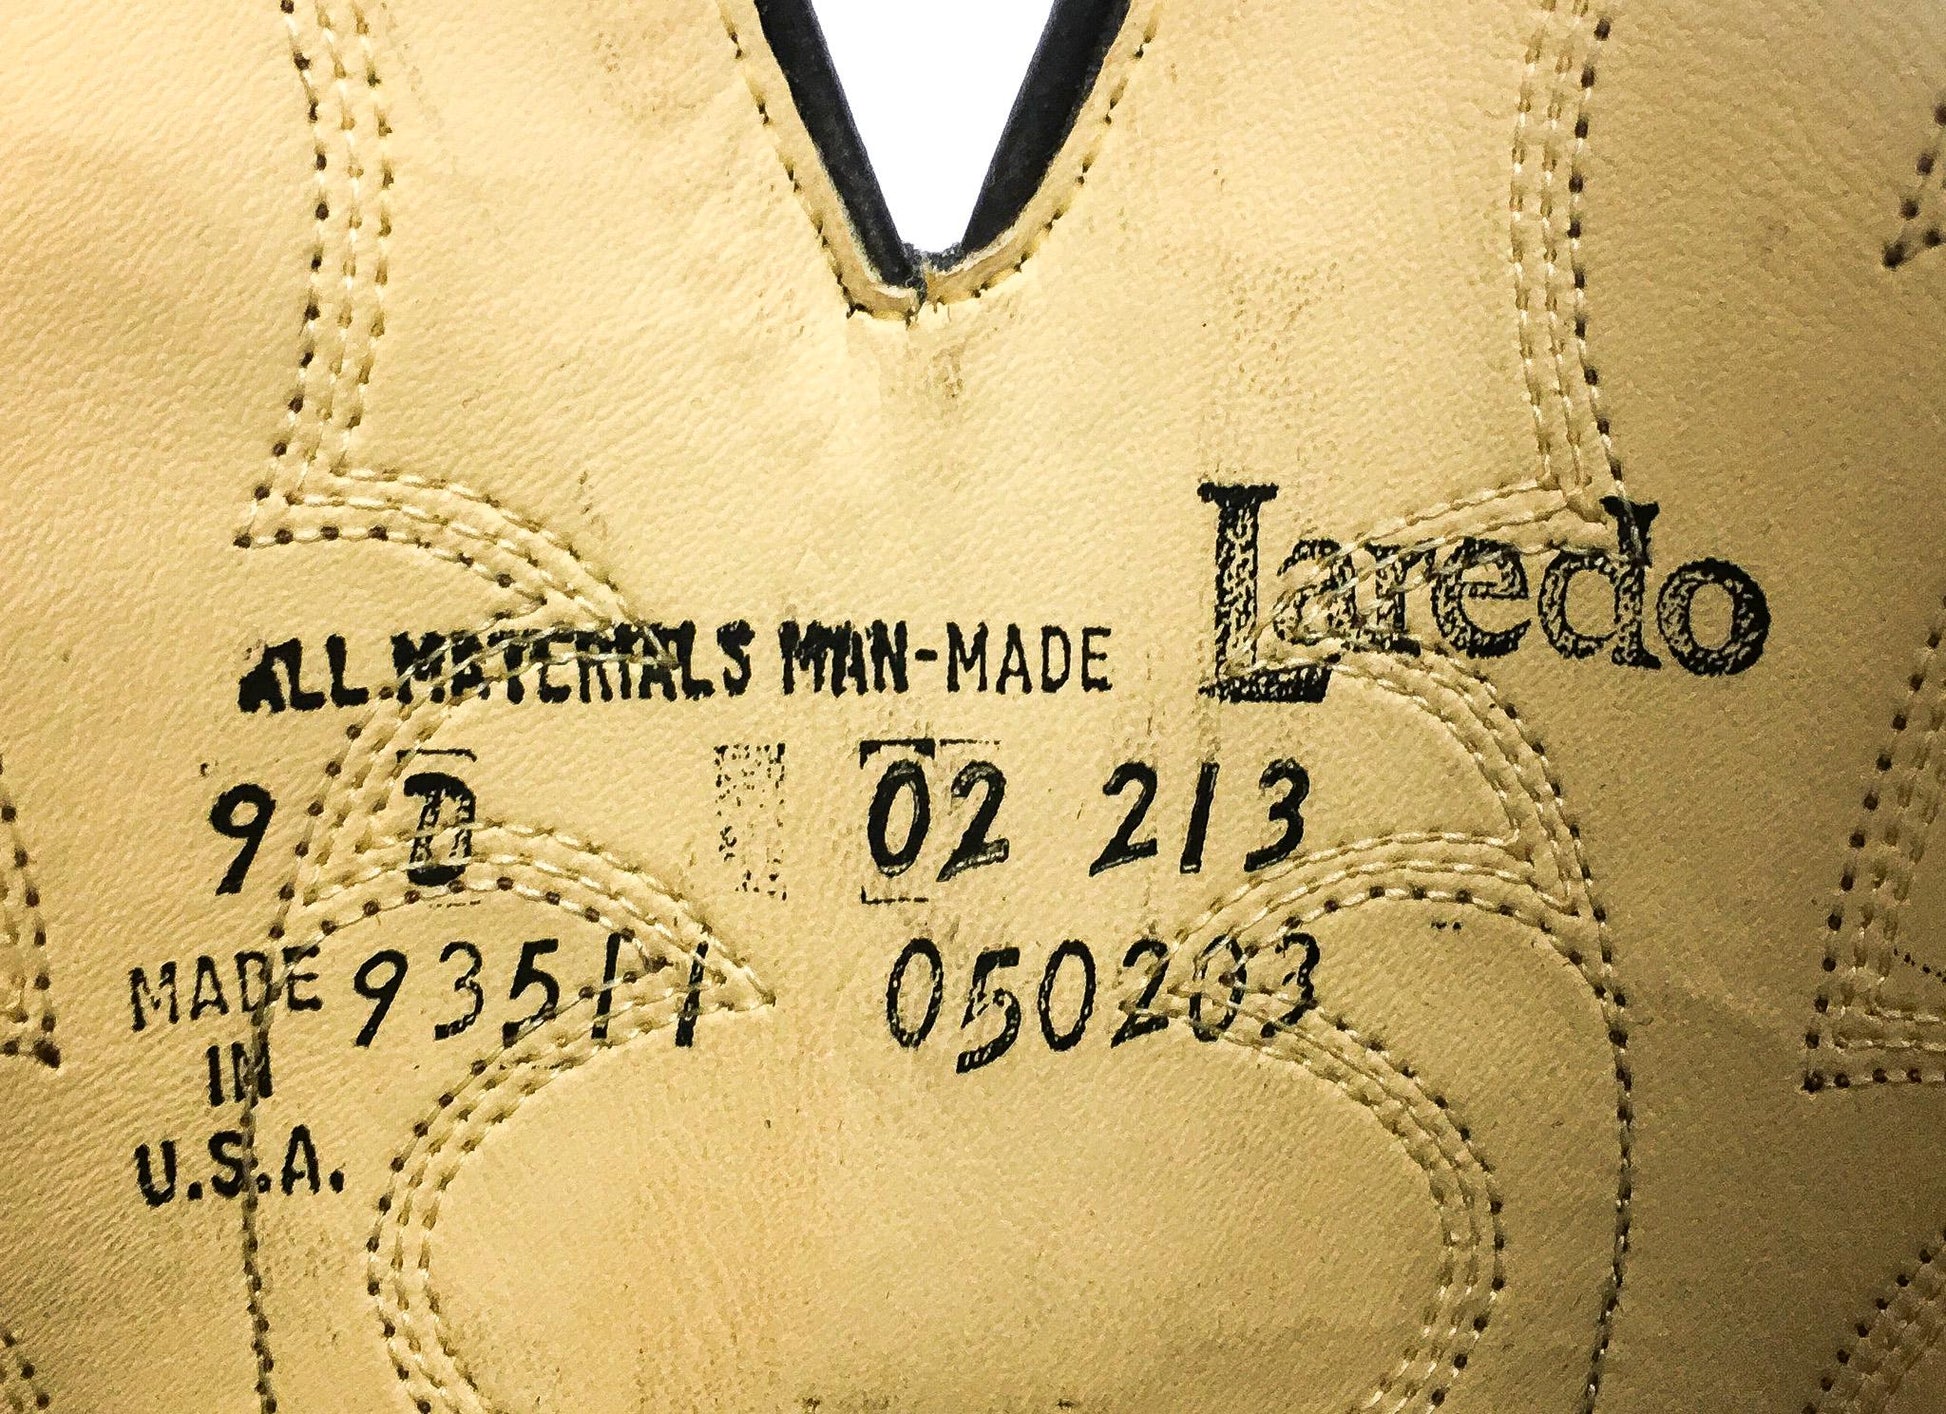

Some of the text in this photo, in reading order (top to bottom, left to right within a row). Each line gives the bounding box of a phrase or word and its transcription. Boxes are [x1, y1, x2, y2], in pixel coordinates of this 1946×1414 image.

[1197, 482, 1772, 704] Laredo
[238, 617, 1113, 714] ALL MATERIALS MAN-MADE
[208, 783, 277, 896] 9
[867, 758, 1010, 884] 02
[128, 942, 325, 1033] MADE
[885, 931, 1322, 1076] 050203
[204, 1036, 274, 1108] IN
[132, 1121, 346, 1208] U.S.A.
